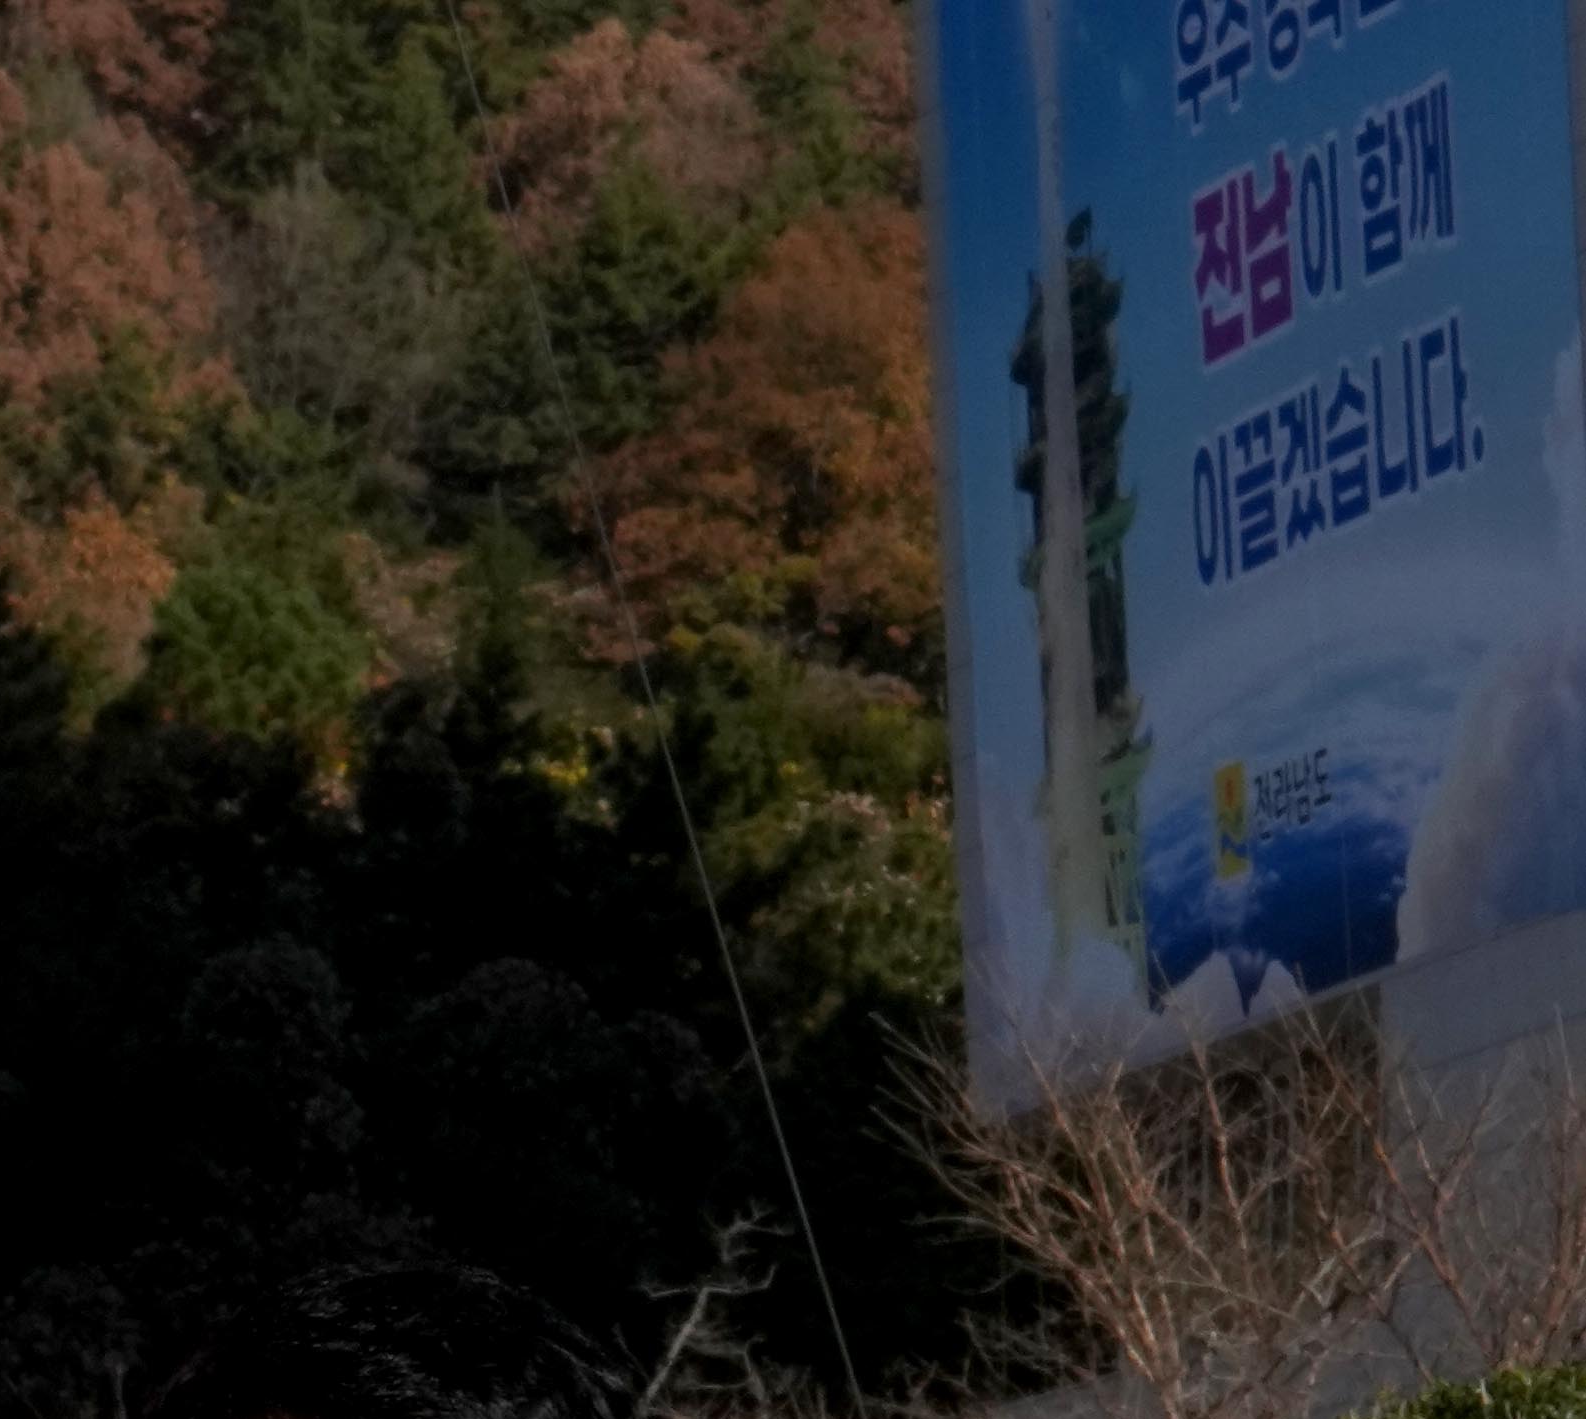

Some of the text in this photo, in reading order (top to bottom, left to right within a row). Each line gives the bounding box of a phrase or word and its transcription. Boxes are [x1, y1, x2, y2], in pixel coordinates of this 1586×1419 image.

[1193, 81, 1455, 366] 전남이 함께
[1194, 316, 1484, 586] 이끌겠습니다.
[1253, 747, 1332, 841] 전라남도
